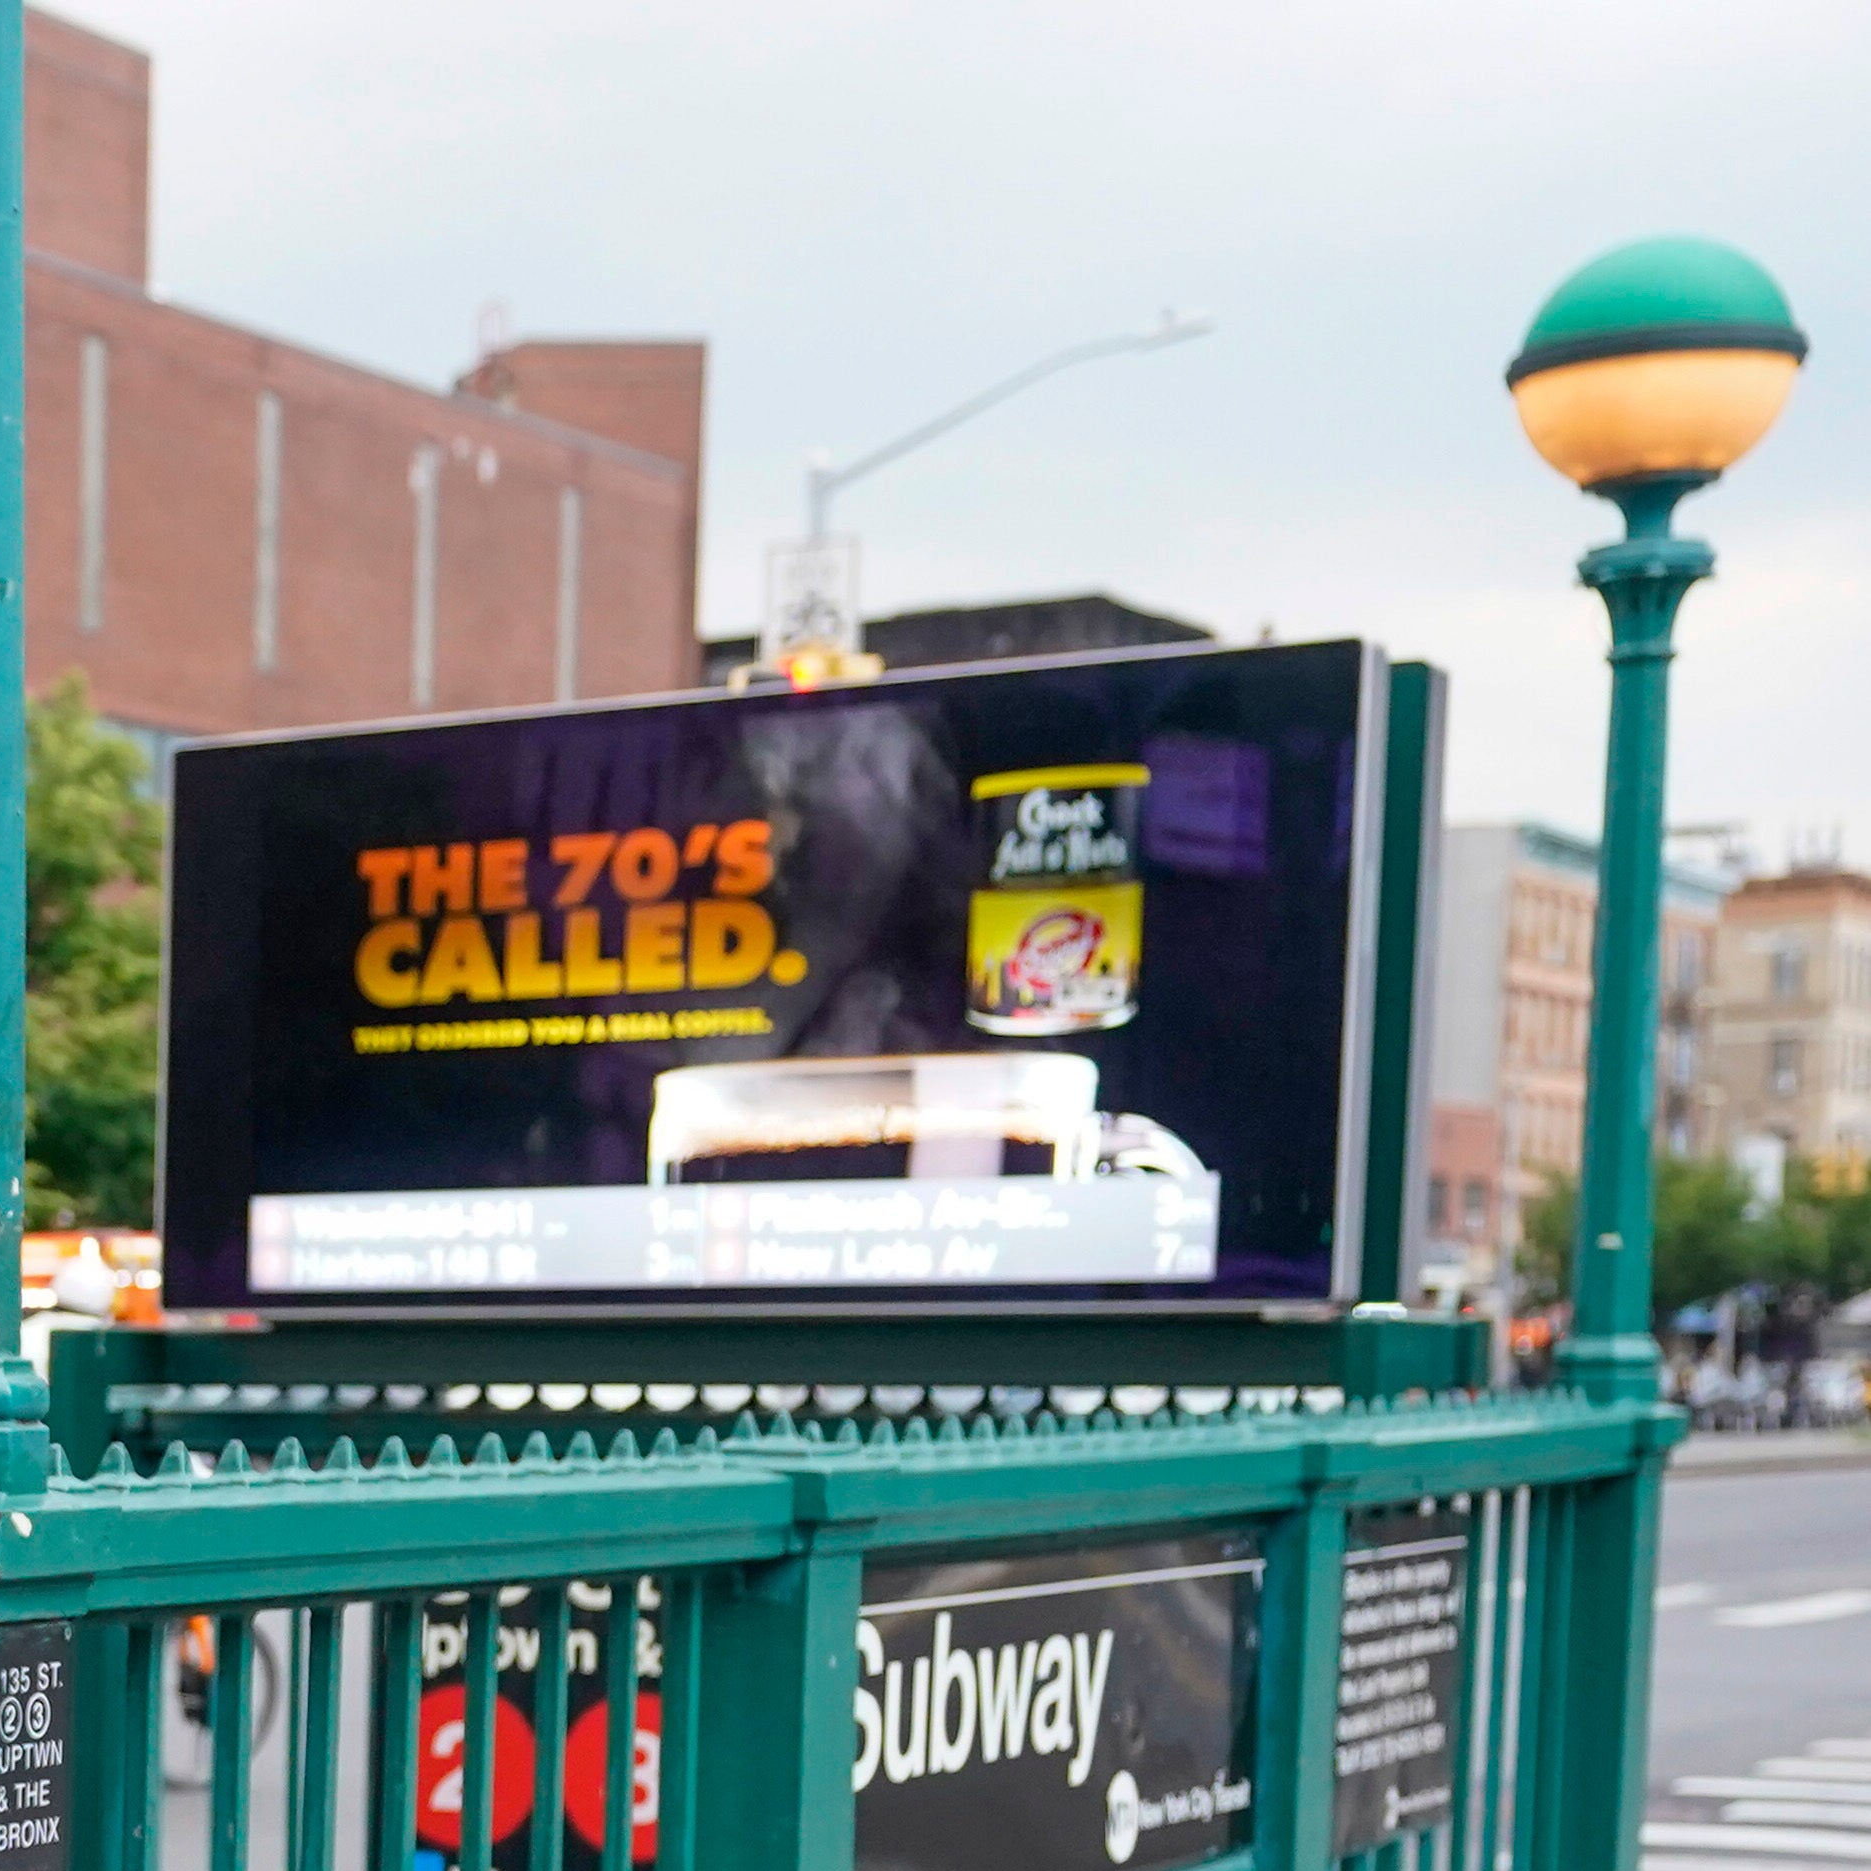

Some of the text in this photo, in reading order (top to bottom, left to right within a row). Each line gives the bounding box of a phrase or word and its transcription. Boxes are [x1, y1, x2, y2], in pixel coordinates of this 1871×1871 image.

[358, 817, 772, 918] THE 70'S
[354, 896, 808, 1009] CALLED.
[0, 1660, 64, 1695] 135 ST.
[852, 1611, 1115, 1794] Subway
[14, 1778, 51, 1810] THE
